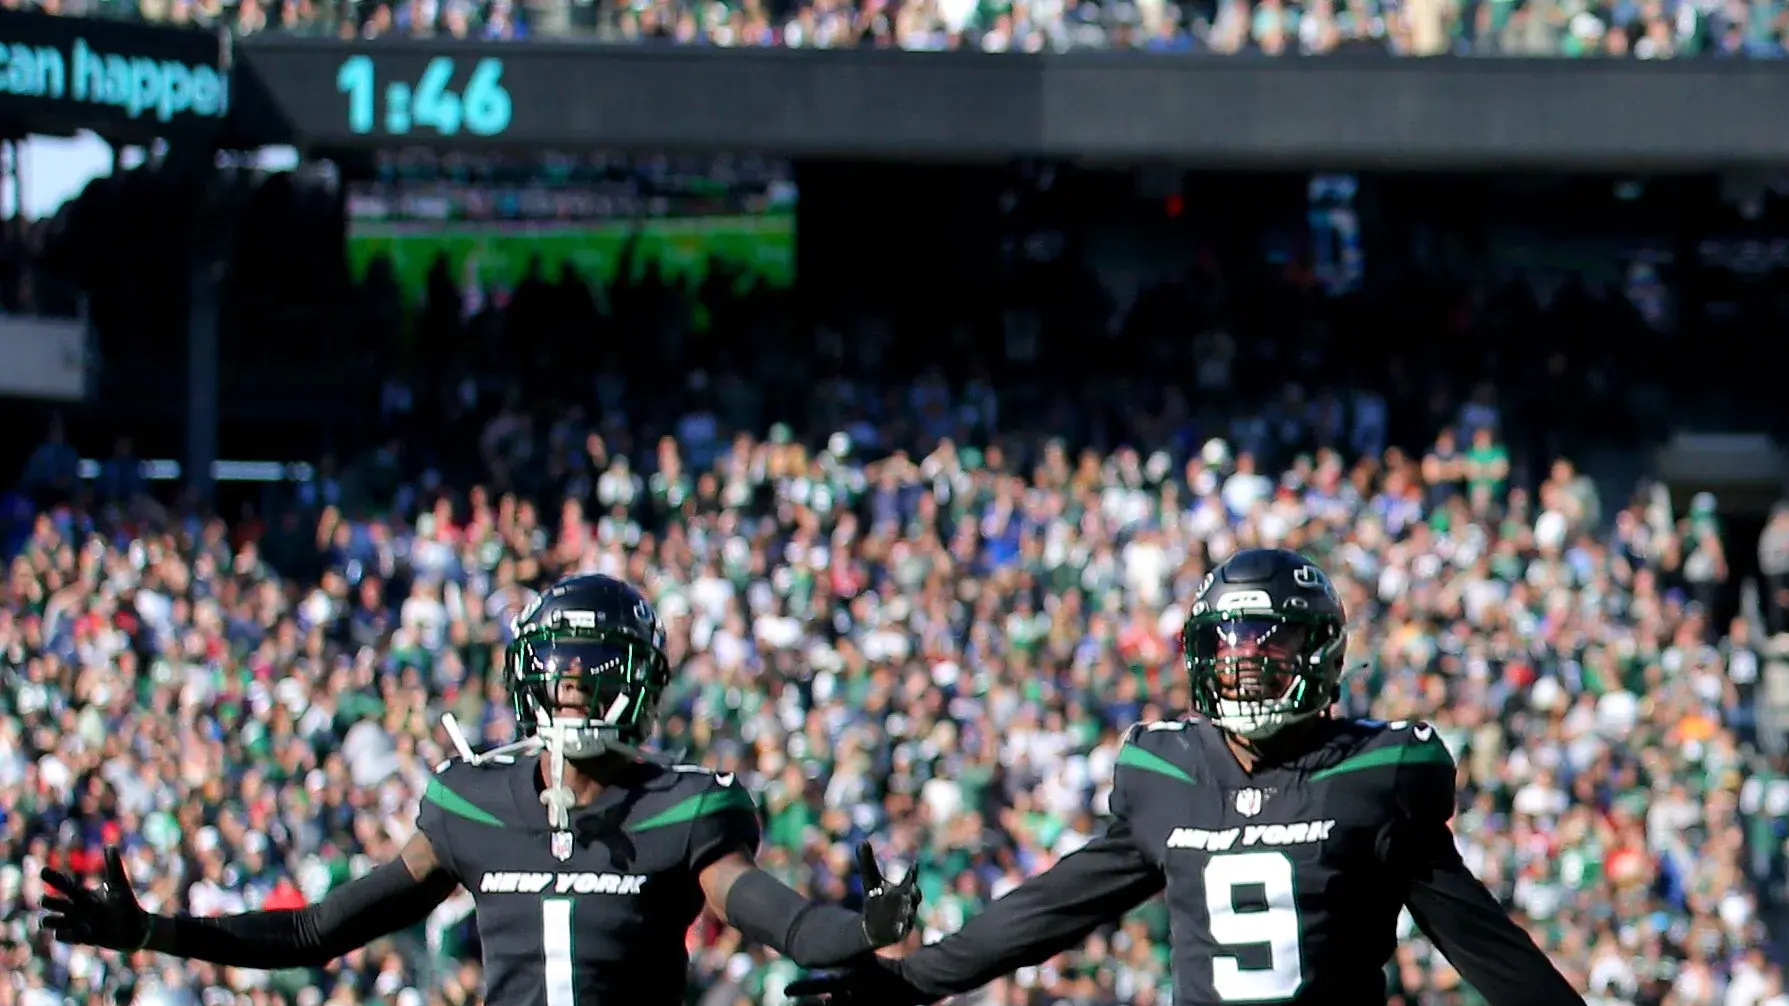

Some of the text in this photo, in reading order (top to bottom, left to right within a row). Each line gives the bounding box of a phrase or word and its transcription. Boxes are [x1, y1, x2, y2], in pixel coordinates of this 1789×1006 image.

[71, 37, 229, 122] happe
[336, 53, 513, 136] 1:46
[1166, 818, 1336, 852] NEW YORK
[480, 871, 648, 895] NEW YORK
[1203, 851, 1303, 1003] 9
